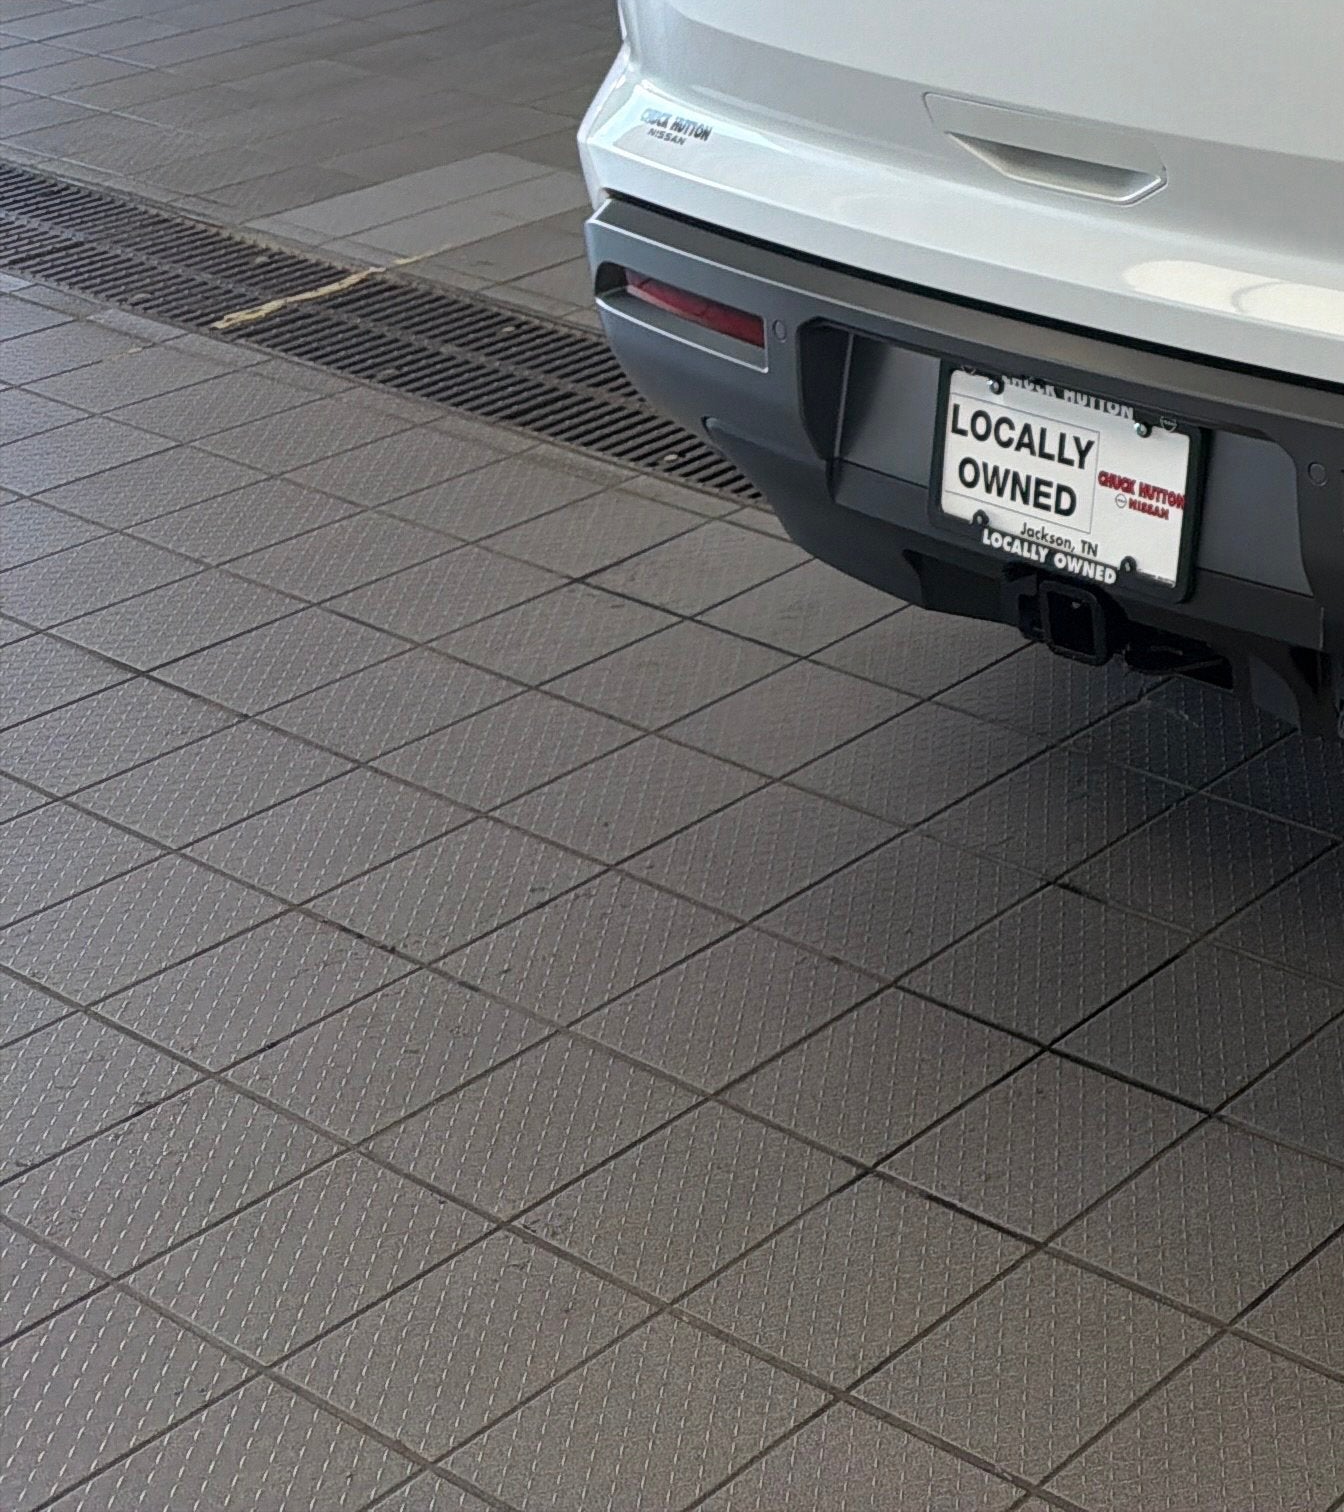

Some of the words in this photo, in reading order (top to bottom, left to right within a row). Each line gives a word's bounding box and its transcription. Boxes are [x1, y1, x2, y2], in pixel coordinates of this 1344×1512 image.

[647, 128, 687, 145] NISSAN
[950, 403, 1096, 470] LOCALLY
[958, 456, 1077, 517] OWNED
[1098, 470, 1136, 495] CHUCK
[1138, 481, 1185, 510] HUTTON
[1128, 497, 1169, 520] NISSAN
[982, 528, 1050, 564] LOCALLY
[1053, 552, 1117, 585] OWNED
[1020, 522, 1076, 553] Jackson,
[1080, 540, 1099, 557] TN
